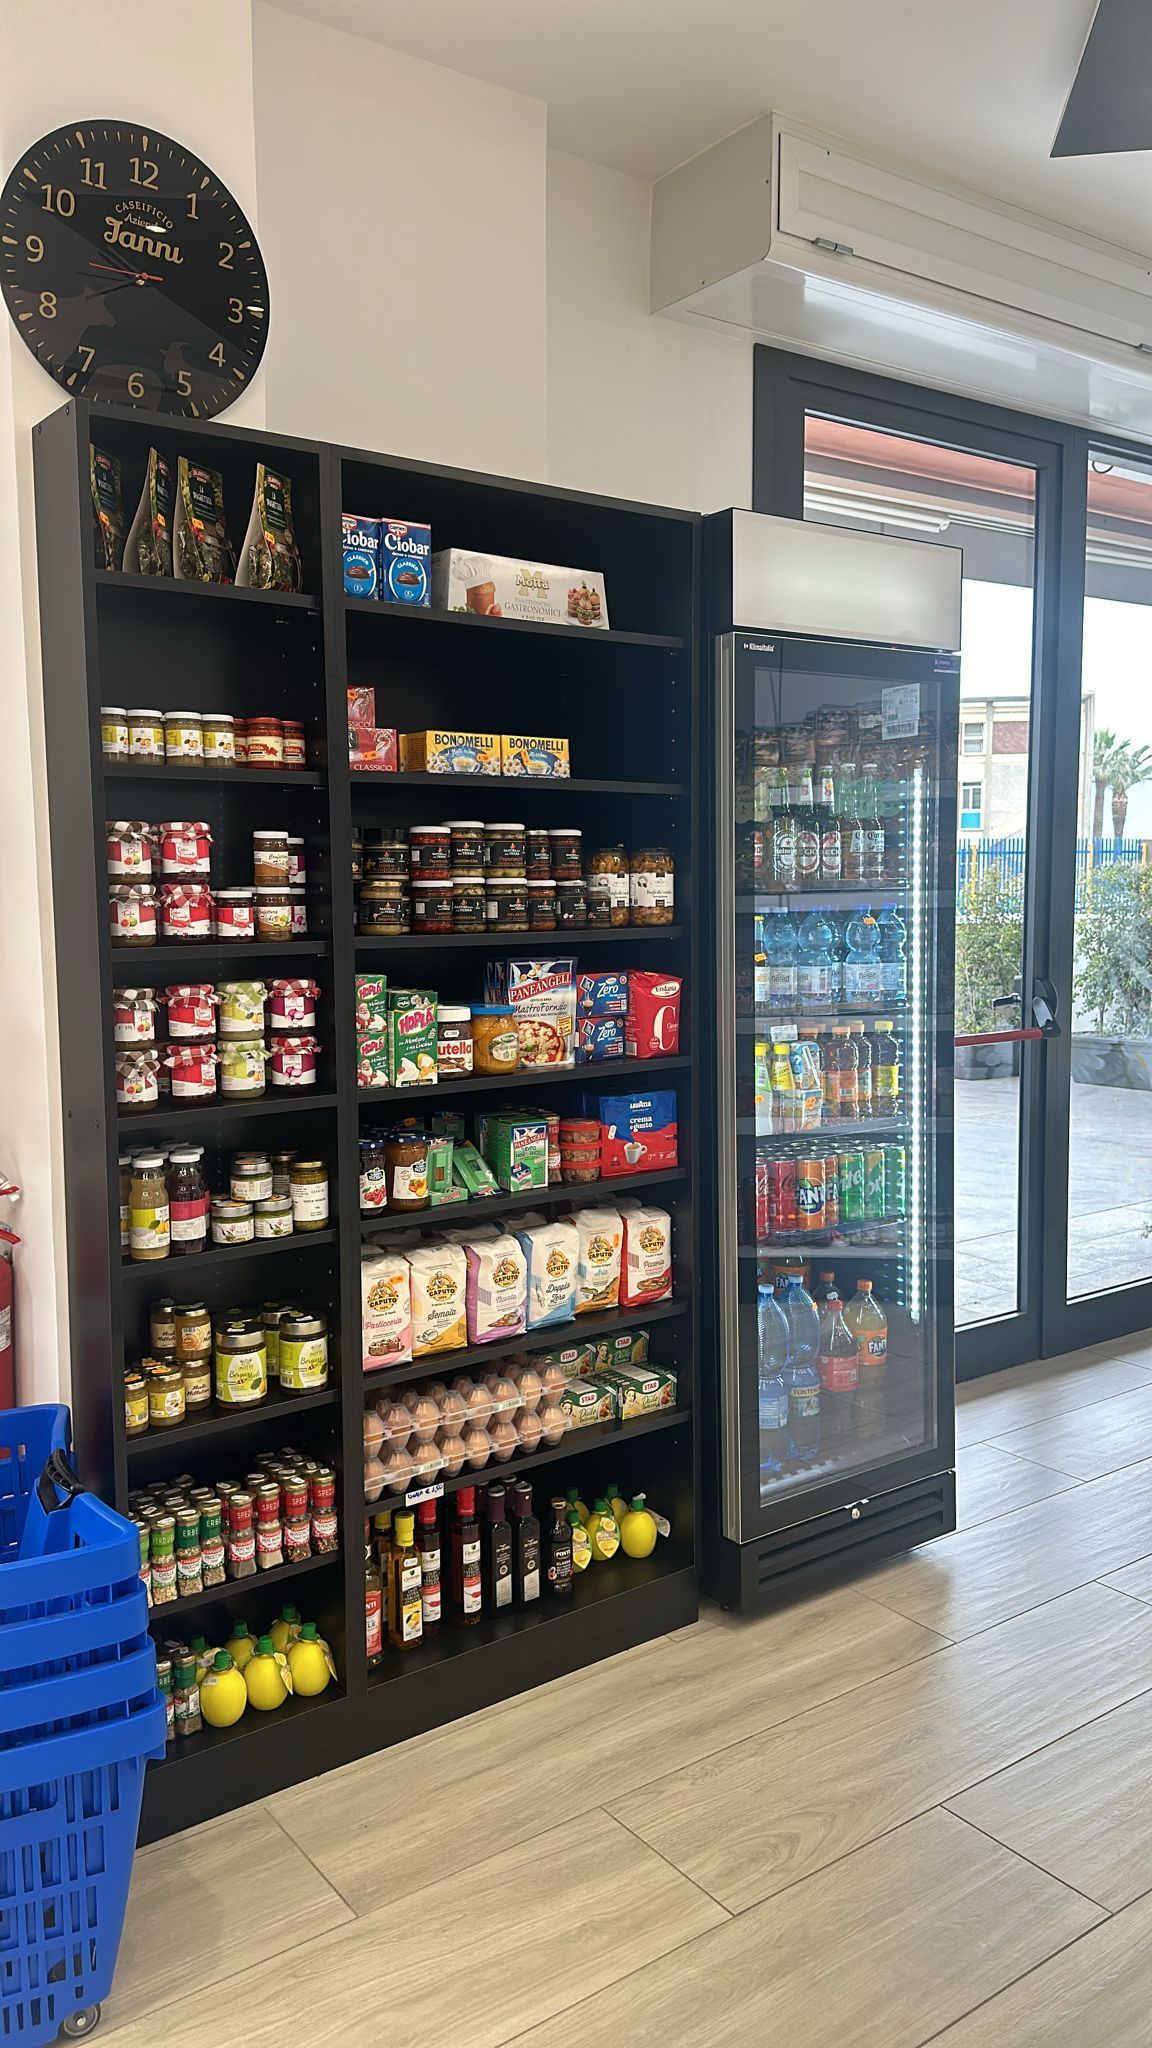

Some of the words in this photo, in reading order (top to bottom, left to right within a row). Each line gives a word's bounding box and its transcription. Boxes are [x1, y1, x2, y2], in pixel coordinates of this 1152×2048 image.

[80, 157, 107, 190] 11
[129, 157, 160, 190] 12
[41, 183, 76, 218] 10
[186, 193, 199, 219] 1
[115, 200, 174, 229] CASEIFICIO
[25, 235, 44, 263] 9
[218, 242, 234, 270] 2
[38, 291, 57, 319] 8
[228, 298, 243, 324] 3
[78, 345, 96, 373] 7
[208, 342, 226, 368] 4
[127, 372, 145, 398] 6
[176, 370, 192, 397] 5
[384, 533, 430, 556] Ciobar
[516, 574, 550, 591] Motta
[504, 602, 561, 618] GASTRONOMICI
[434, 733, 493, 749] BONOMELLI
[509, 738, 564, 752] BONOMELLI
[353, 763, 393, 772] CLASSICO
[510, 973, 572, 1001] PANEANGELI
[596, 982, 619, 998] Zero
[596, 1026, 616, 1042] Zero
[630, 1100, 652, 1109] LAVAZZA
[629, 1116, 653, 1124] crema
[633, 1122, 653, 1132] gusto
[642, 1241, 664, 1249] CAPUTO
[588, 1251, 613, 1260] CAPUTO
[547, 1264, 569, 1274] CAPUTO
[494, 1274, 518, 1285] CAPUTO
[429, 1287, 455, 1297] CAPUTO
[546, 1282, 571, 1294] Doppio
[369, 1297, 397, 1308] CAPUTO
[551, 1293, 566, 1304] Zero
[427, 1308, 457, 1321] Semola
[365, 1317, 402, 1330] Pasticceria
[617, 1337, 630, 1347] STAR
[562, 1351, 576, 1361] STAR
[644, 1381, 658, 1391] STAR
[581, 1393, 596, 1403] STAR
[555, 1549, 571, 1557] PONTI
